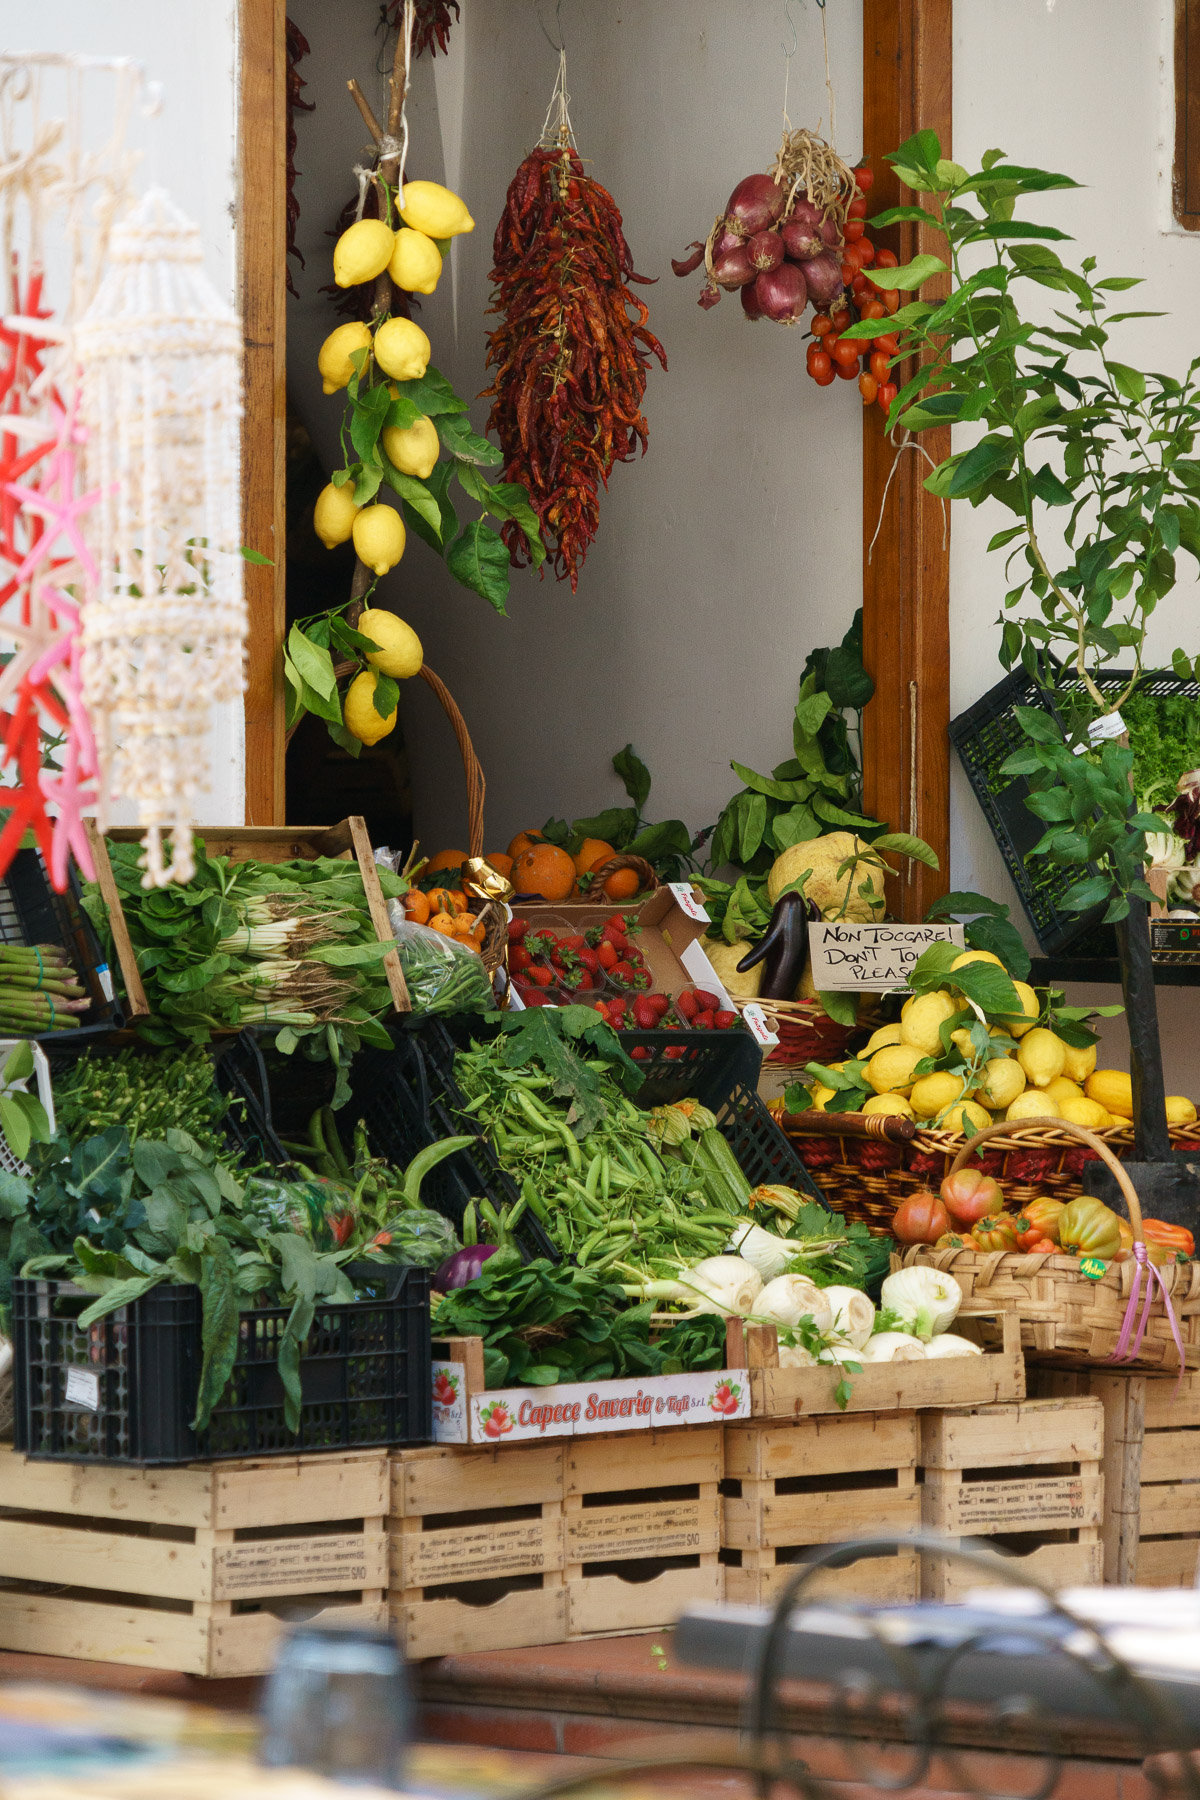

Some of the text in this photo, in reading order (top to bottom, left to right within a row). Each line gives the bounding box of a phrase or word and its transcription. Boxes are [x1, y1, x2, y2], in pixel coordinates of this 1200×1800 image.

[823, 926, 861, 943] NON
[824, 946, 882, 965] DON'T
[518, 1399, 581, 1433] Capece
[584, 1390, 654, 1422] Saverio
[655, 1397, 666, 1414] &
[666, 1395, 690, 1417] Figli
